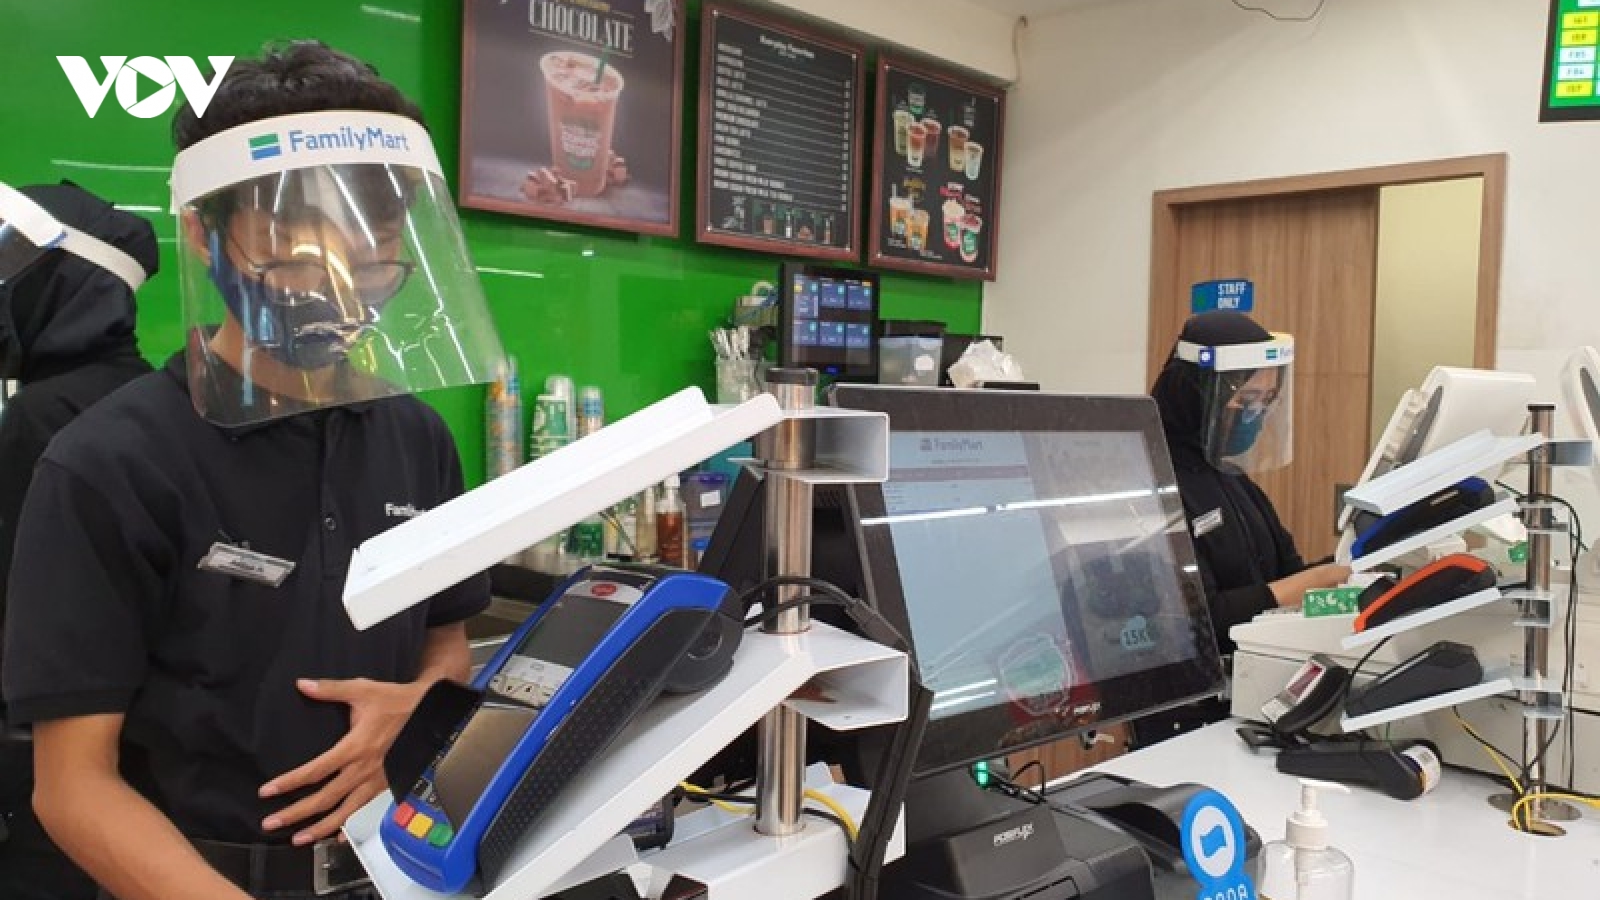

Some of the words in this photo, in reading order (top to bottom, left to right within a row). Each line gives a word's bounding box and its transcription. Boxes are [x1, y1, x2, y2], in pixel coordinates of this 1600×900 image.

[528, 0, 635, 52] CHOCOLATE
[288, 127, 409, 154] FamilyMart
[1217, 281, 1247, 296] STAFF
